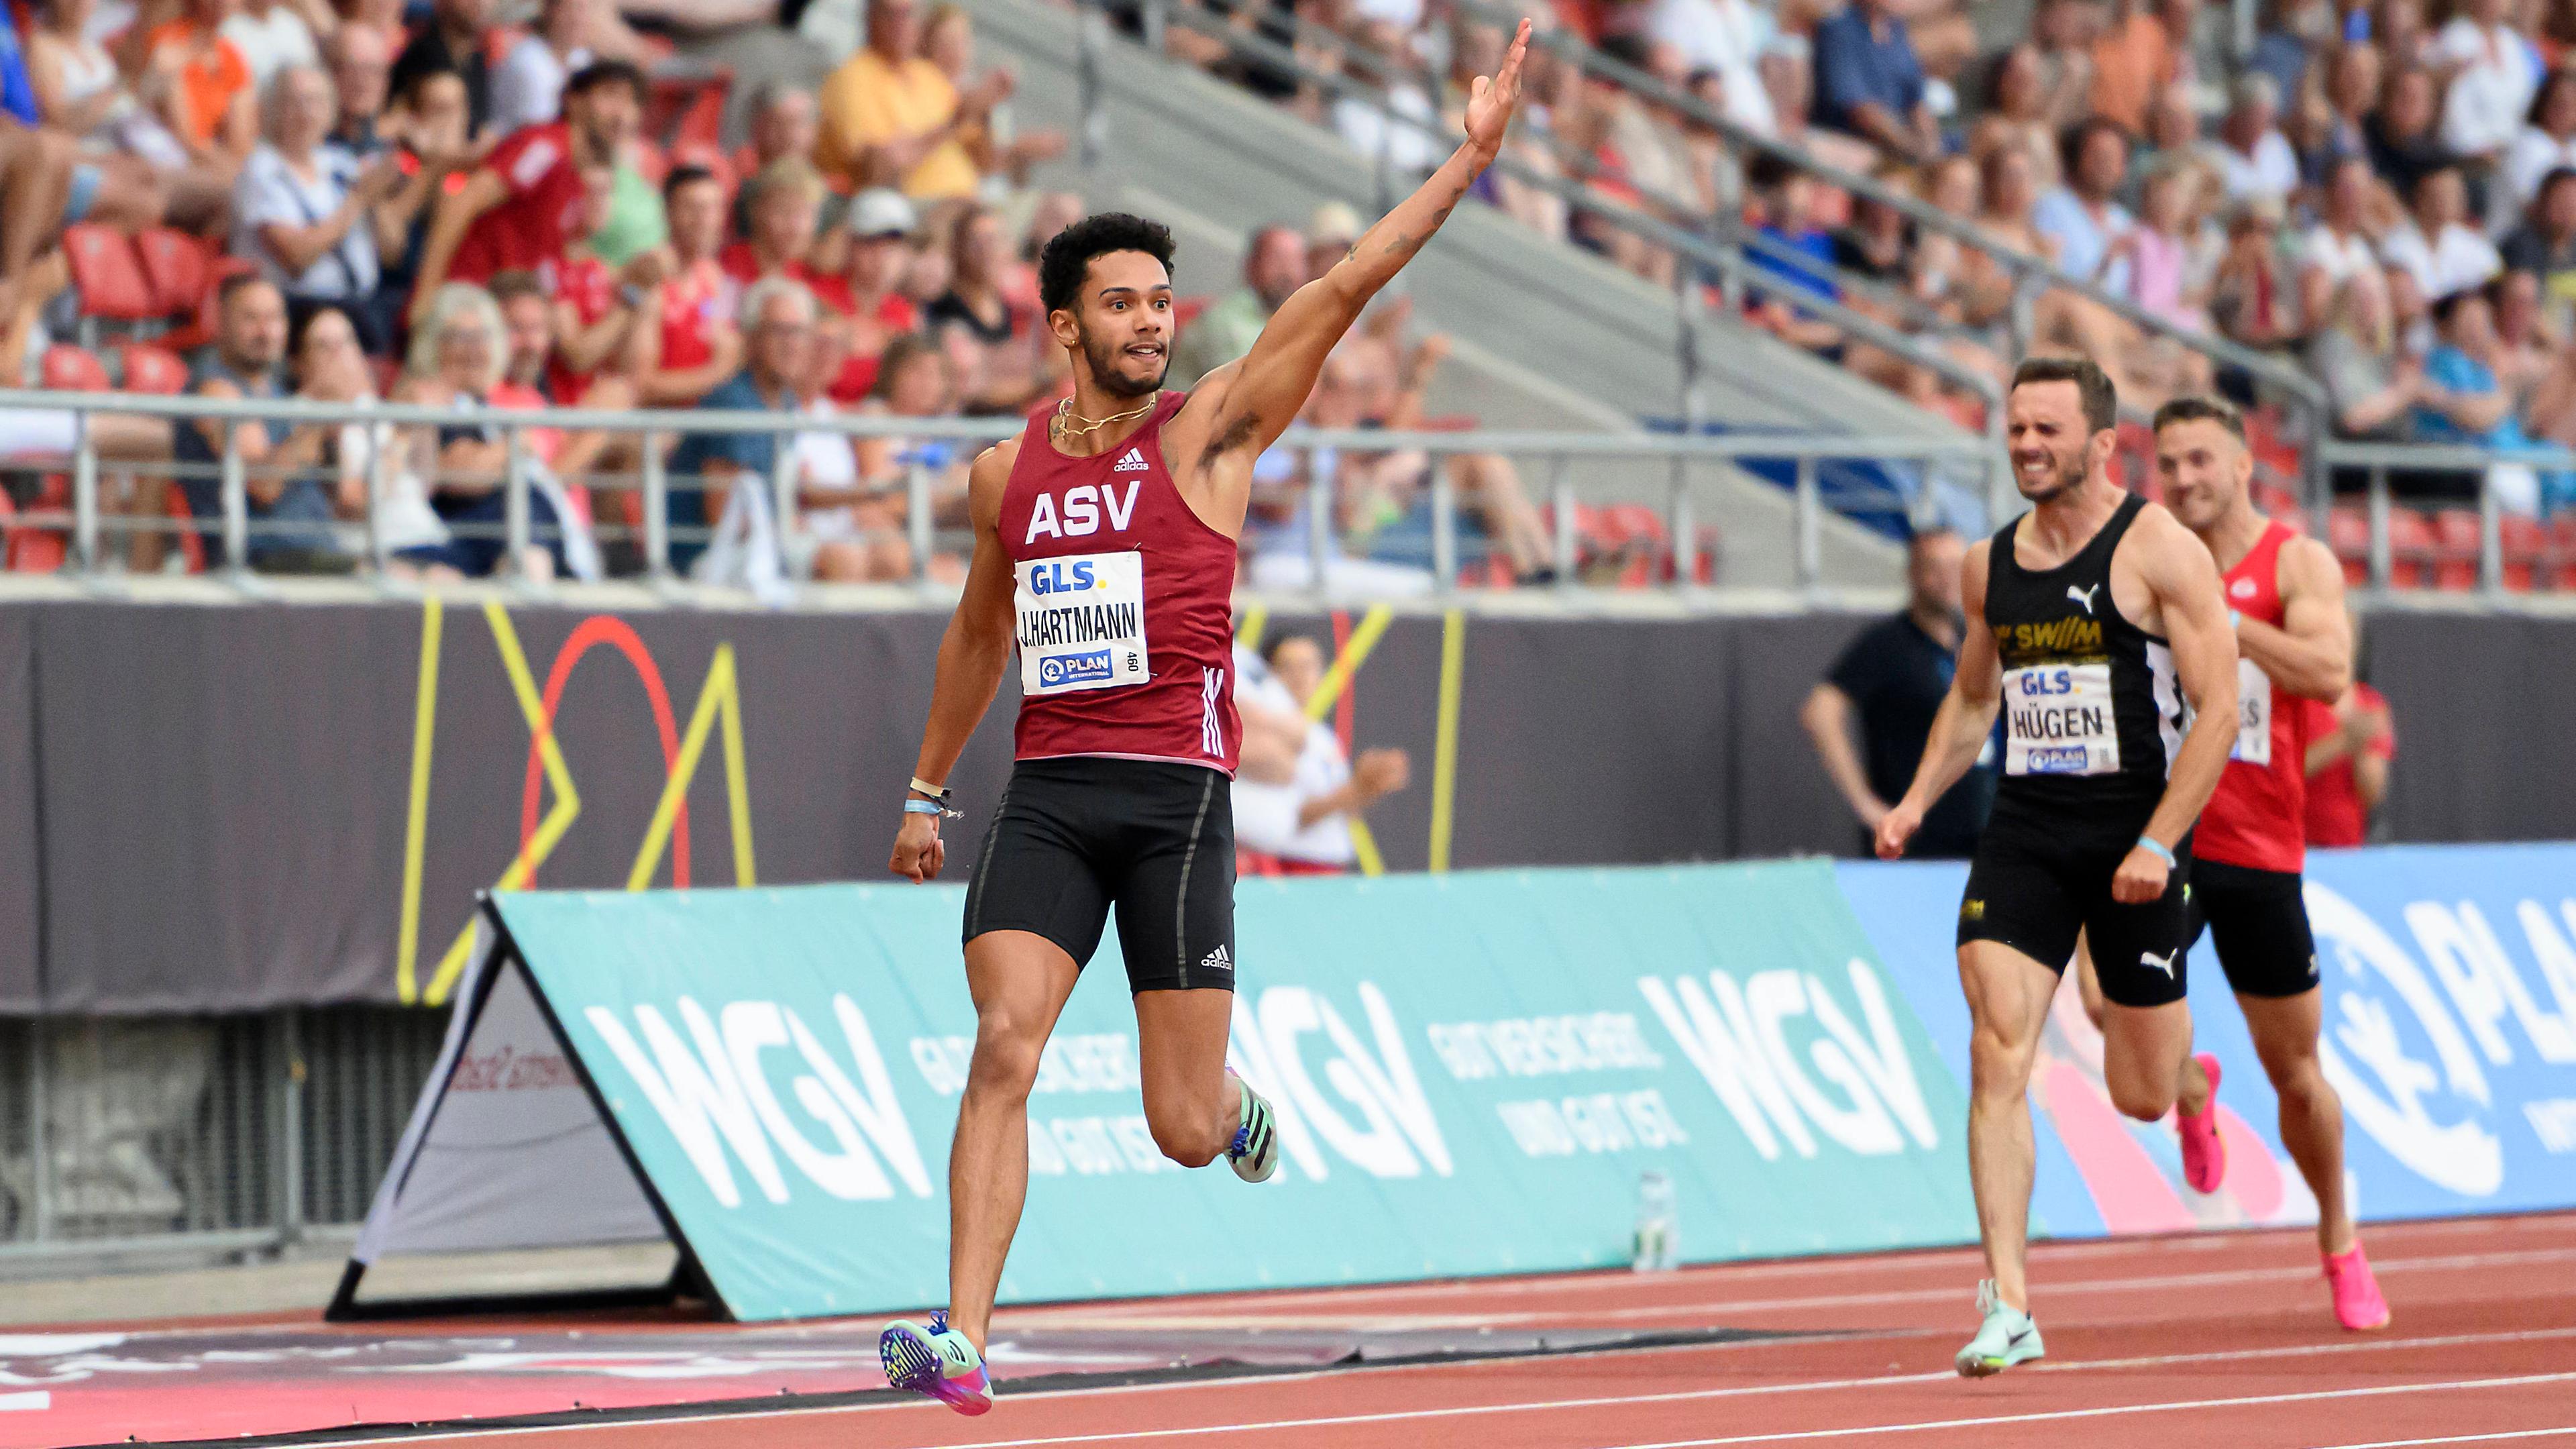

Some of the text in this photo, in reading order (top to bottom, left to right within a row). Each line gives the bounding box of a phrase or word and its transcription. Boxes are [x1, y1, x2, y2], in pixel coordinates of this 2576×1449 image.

[1114, 462, 1149, 472] adidas
[1025, 480, 1140, 545] ASV
[1020, 602, 1136, 647] J.HARTMANN
[1065, 655, 1110, 672] PLAN
[1127, 651, 1139, 672] 460
[2014, 702, 2103, 739] HÜGEN
[1637, 956, 1938, 1163] WGV
[583, 991, 934, 1208] WGV
